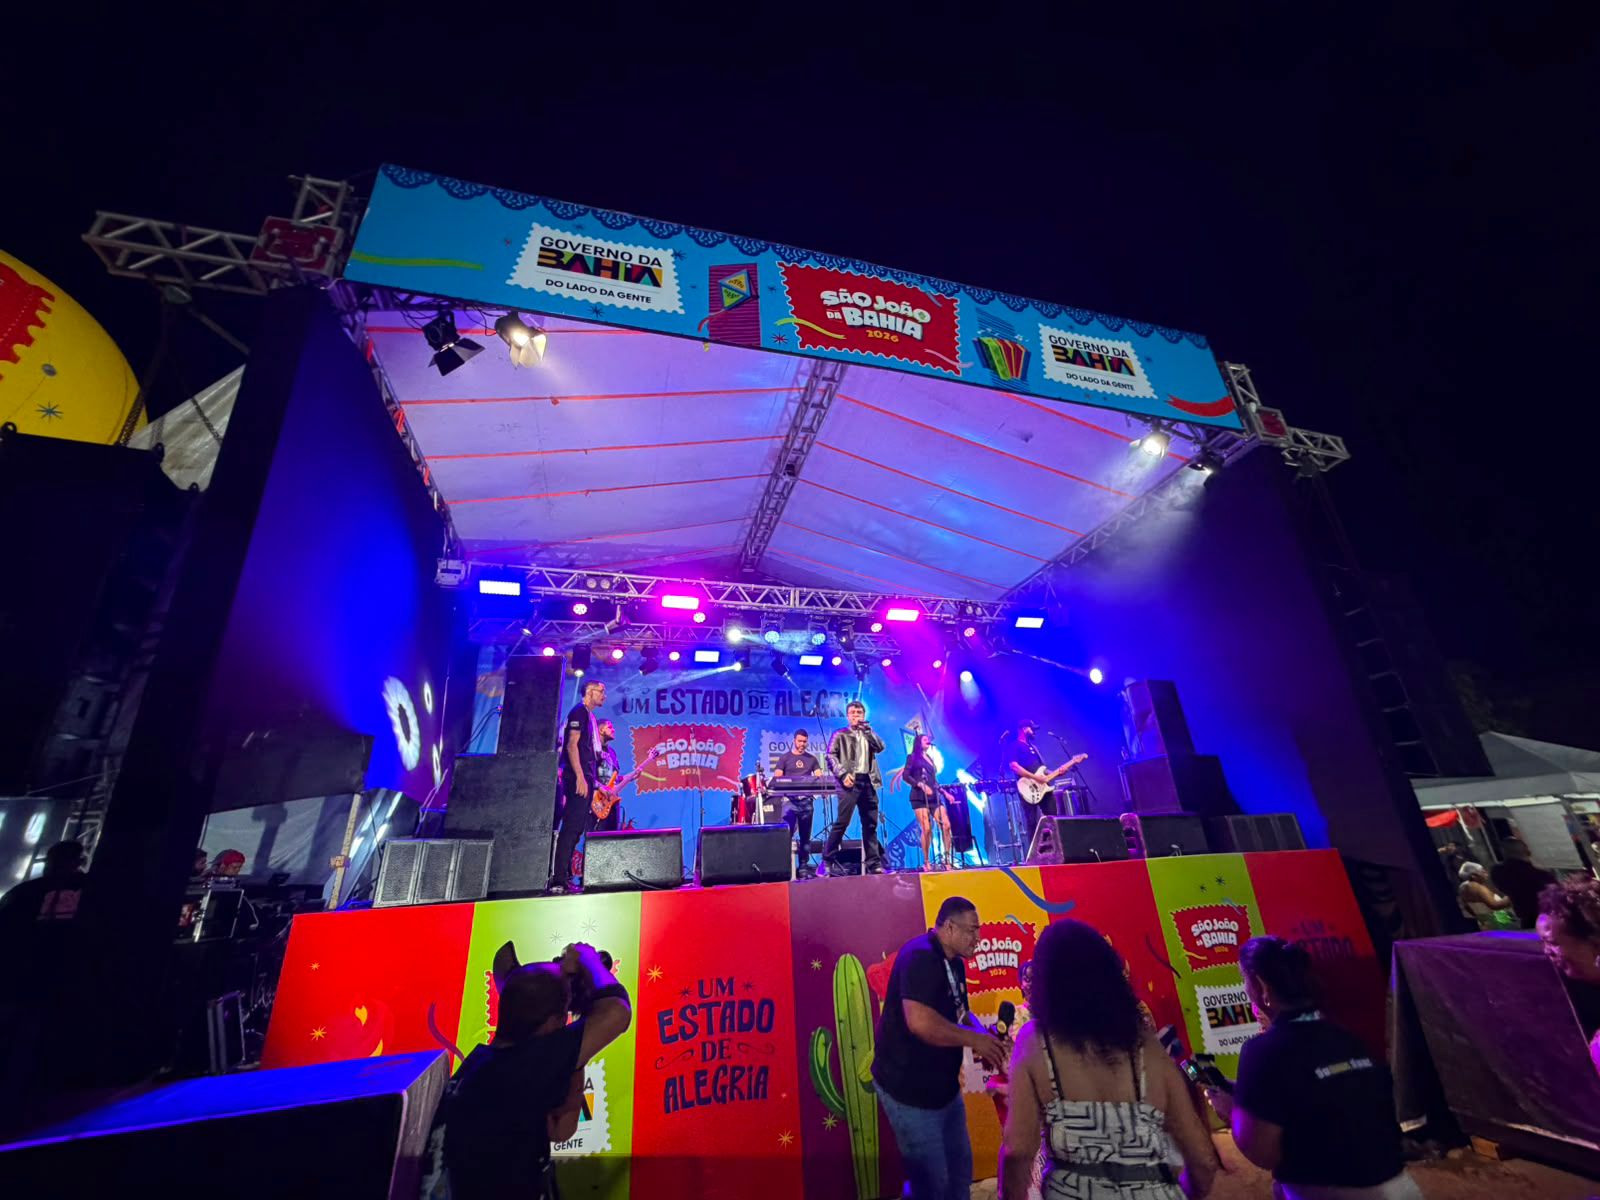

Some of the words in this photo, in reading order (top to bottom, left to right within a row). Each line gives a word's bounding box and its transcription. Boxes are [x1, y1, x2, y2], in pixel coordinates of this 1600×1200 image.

[540, 236, 633, 262] GOVERNO
[638, 254, 662, 268] DA
[536, 246, 663, 288] BAHIA
[545, 278, 563, 288] DO
[566, 282, 597, 294] LADO
[599, 288, 615, 298] DA
[617, 292, 652, 303] GENTE
[826, 309, 843, 320] DA
[841, 306, 923, 340] BAHIA
[865, 329, 899, 343] 2026
[1048, 334, 1110, 355] GOVERNO
[1112, 347, 1130, 359] DA
[1051, 344, 1136, 377] BAHIA
[1065, 372, 1079, 380] DO
[1079, 375, 1100, 384] LADO
[1112, 381, 1136, 391] GENTE
[621, 697, 650, 714] UM
[656, 688, 743, 716] ESTADO
[748, 695, 770, 710] DE
[656, 757, 667, 767] DA
[666, 752, 720, 770] BAHIA
[1201, 931, 1238, 948] BAHIA
[975, 952, 1018, 971] BAHIA
[698, 977, 734, 999] UM
[1203, 991, 1247, 1007] GOVERNO
[657, 998, 775, 1045] ESTADO
[701, 1038, 732, 1063] DE
[663, 1064, 769, 1114] ALEGRIA
[553, 1138, 583, 1151] GENTE
